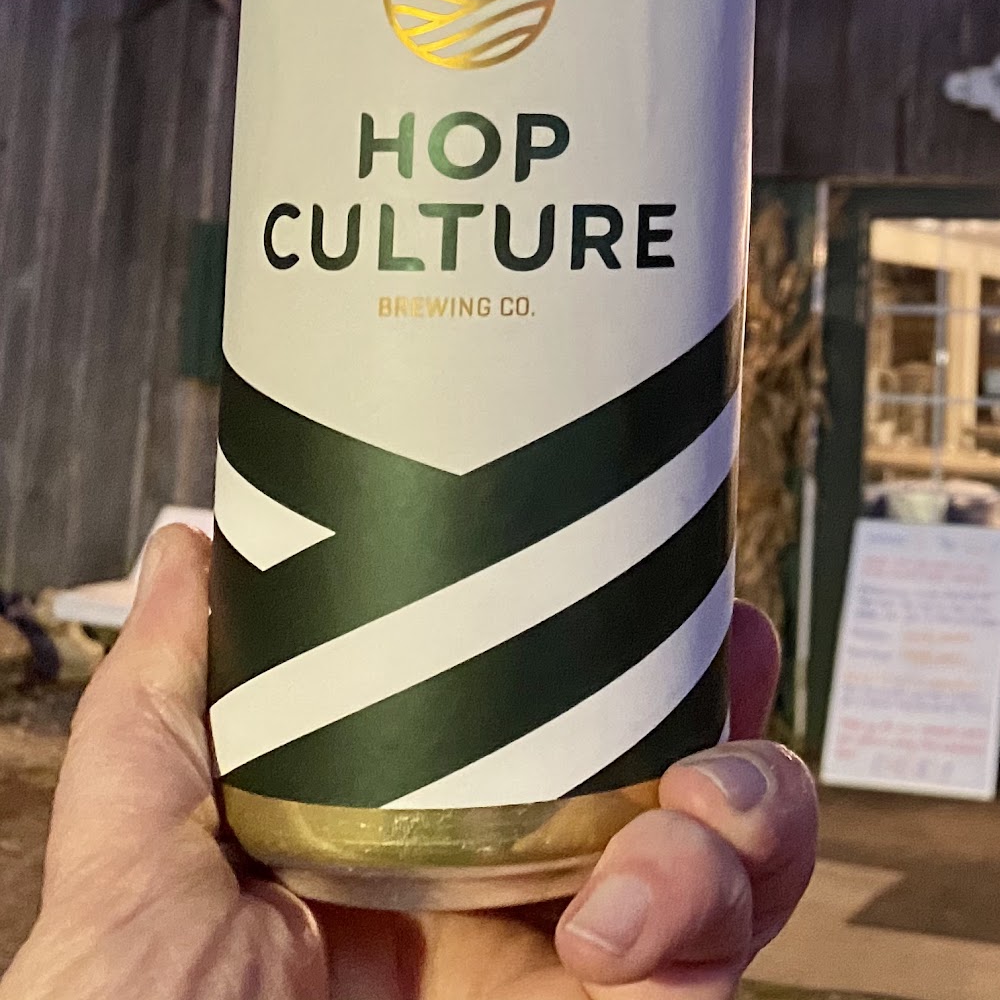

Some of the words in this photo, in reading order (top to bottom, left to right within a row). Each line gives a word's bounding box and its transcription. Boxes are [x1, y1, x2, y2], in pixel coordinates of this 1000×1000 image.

[359, 111, 570, 182] HOP
[264, 202, 677, 271] CULTURE
[379, 296, 491, 318] BREWING
[500, 297, 536, 317] CO.
